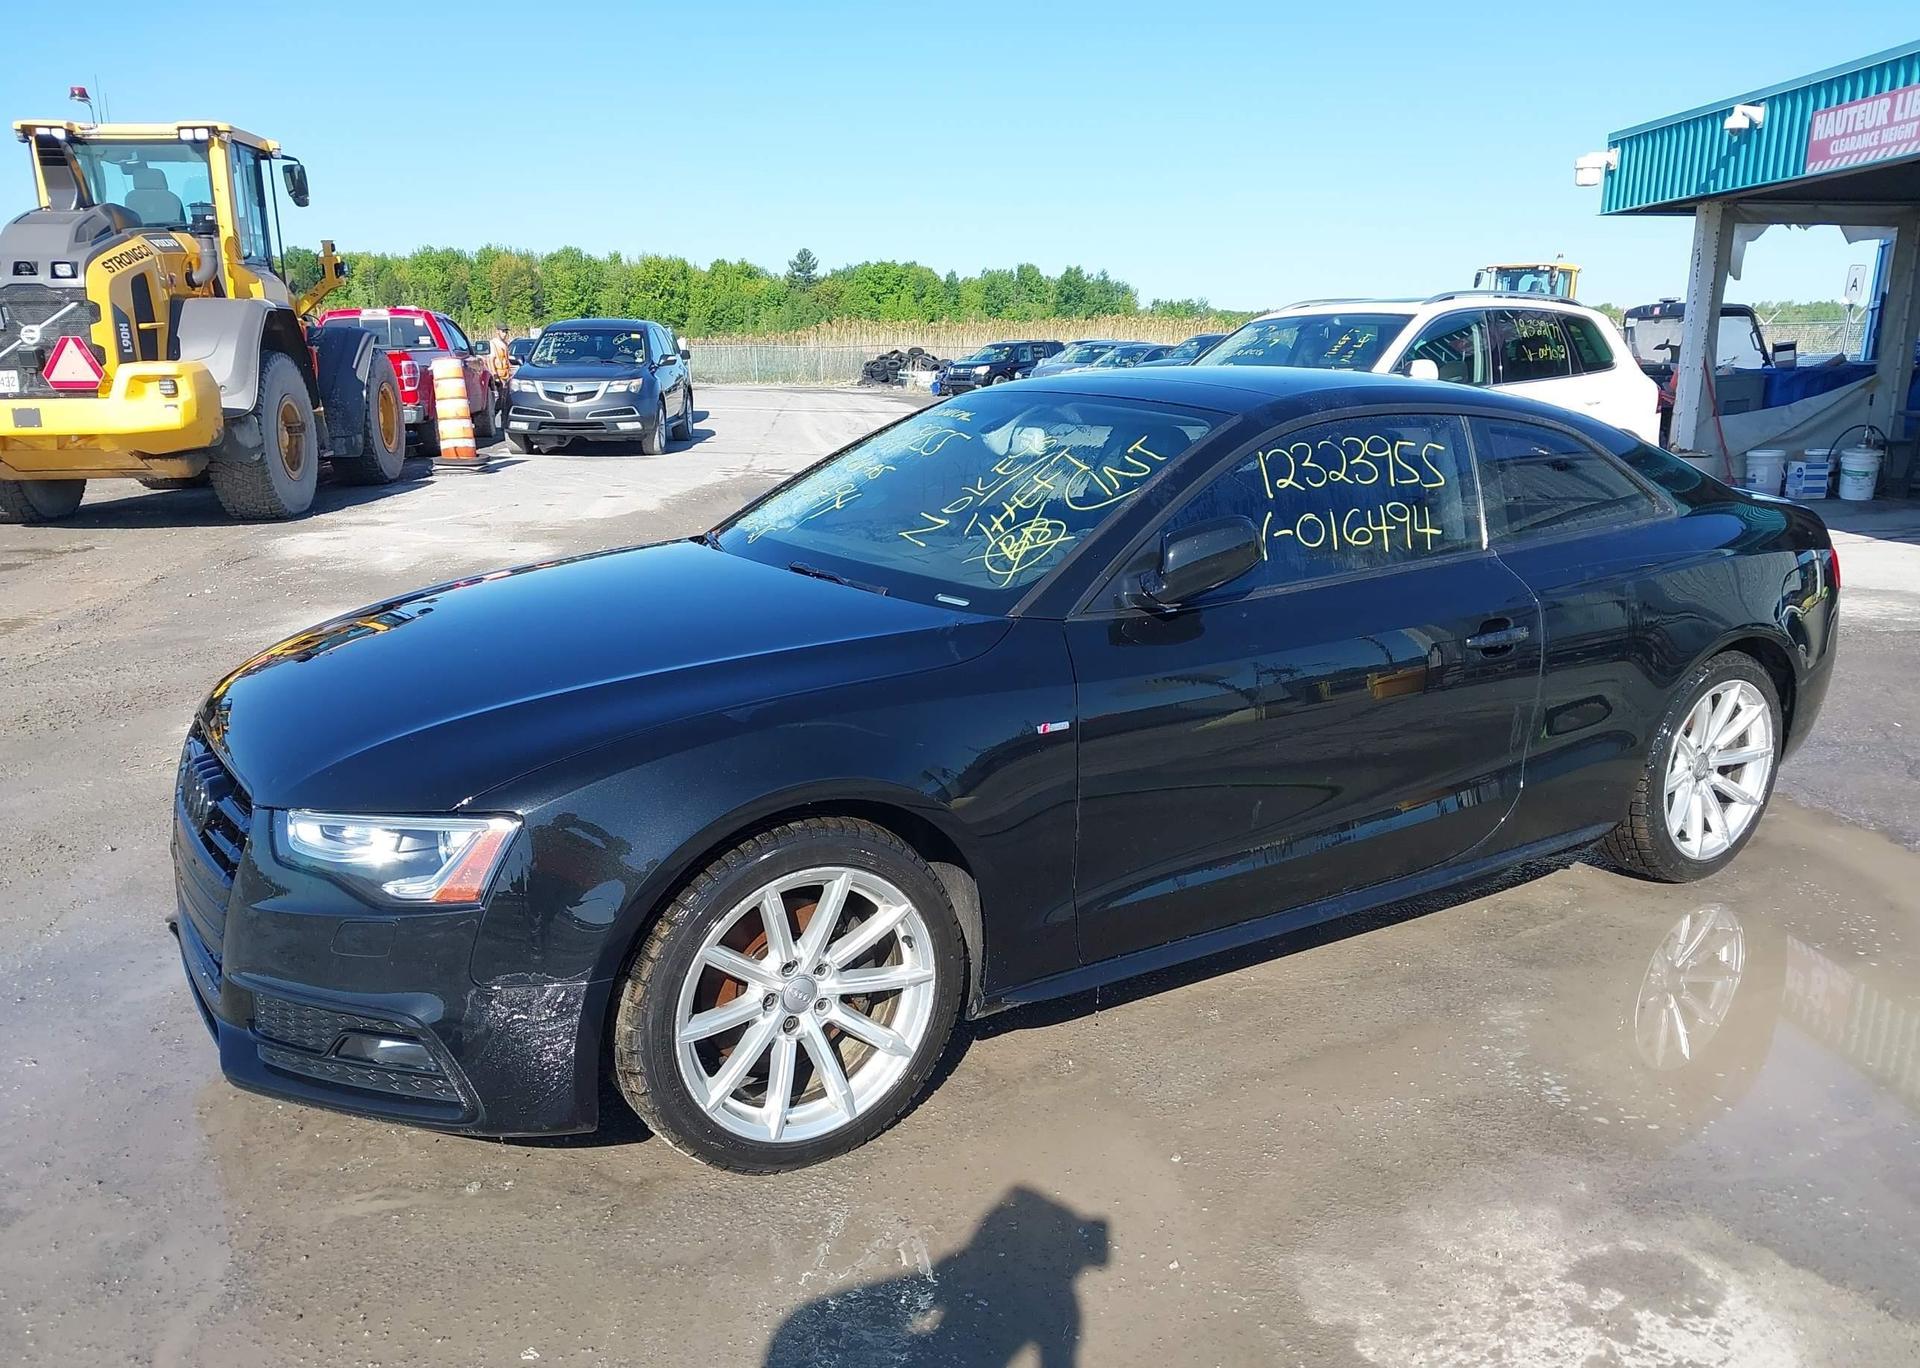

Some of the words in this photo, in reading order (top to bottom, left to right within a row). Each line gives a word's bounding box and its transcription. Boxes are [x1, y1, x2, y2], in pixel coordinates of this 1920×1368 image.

[1813, 98, 1891, 141] HAUTEUR
[1830, 130, 1880, 155] CLEARANCE
[1880, 121, 1919, 145] HEIGHT
[101, 244, 154, 273] STRONGCO
[1849, 277, 1858, 291] A
[119, 322, 134, 353] L90H
[1257, 435, 1446, 499] 12323955
[1261, 501, 1443, 561] 1-016494
